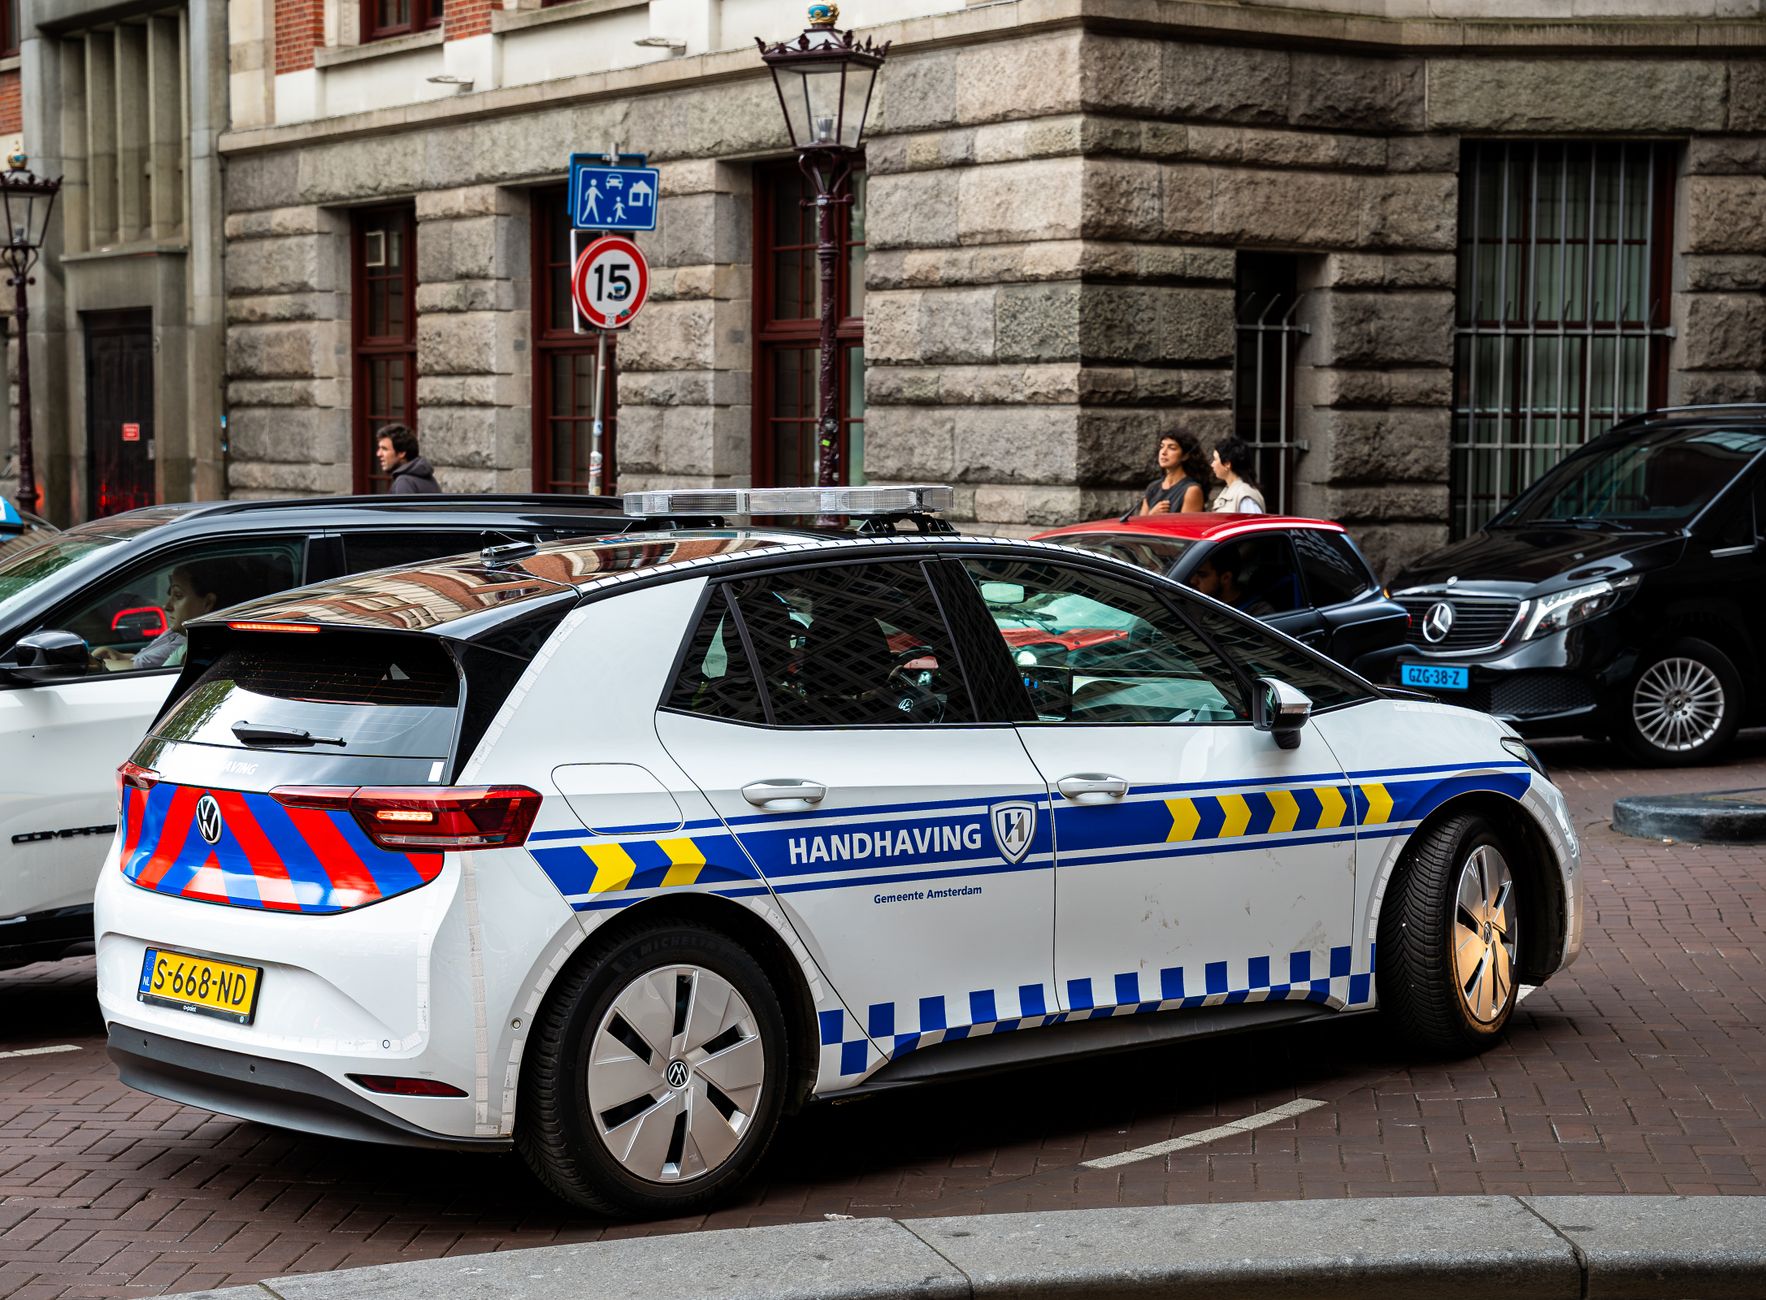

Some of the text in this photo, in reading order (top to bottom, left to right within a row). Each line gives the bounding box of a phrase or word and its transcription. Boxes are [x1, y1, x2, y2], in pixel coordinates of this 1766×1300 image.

[593, 263, 632, 302] 15
[1408, 667, 1460, 686] GZG-38-Z
[11, 824, 118, 845] COMPAS
[787, 823, 982, 865] HANDHAVING
[873, 885, 982, 905] Gemeente Amsterdam
[142, 975, 150, 986] NL
[154, 958, 246, 1006] S-668-ND
